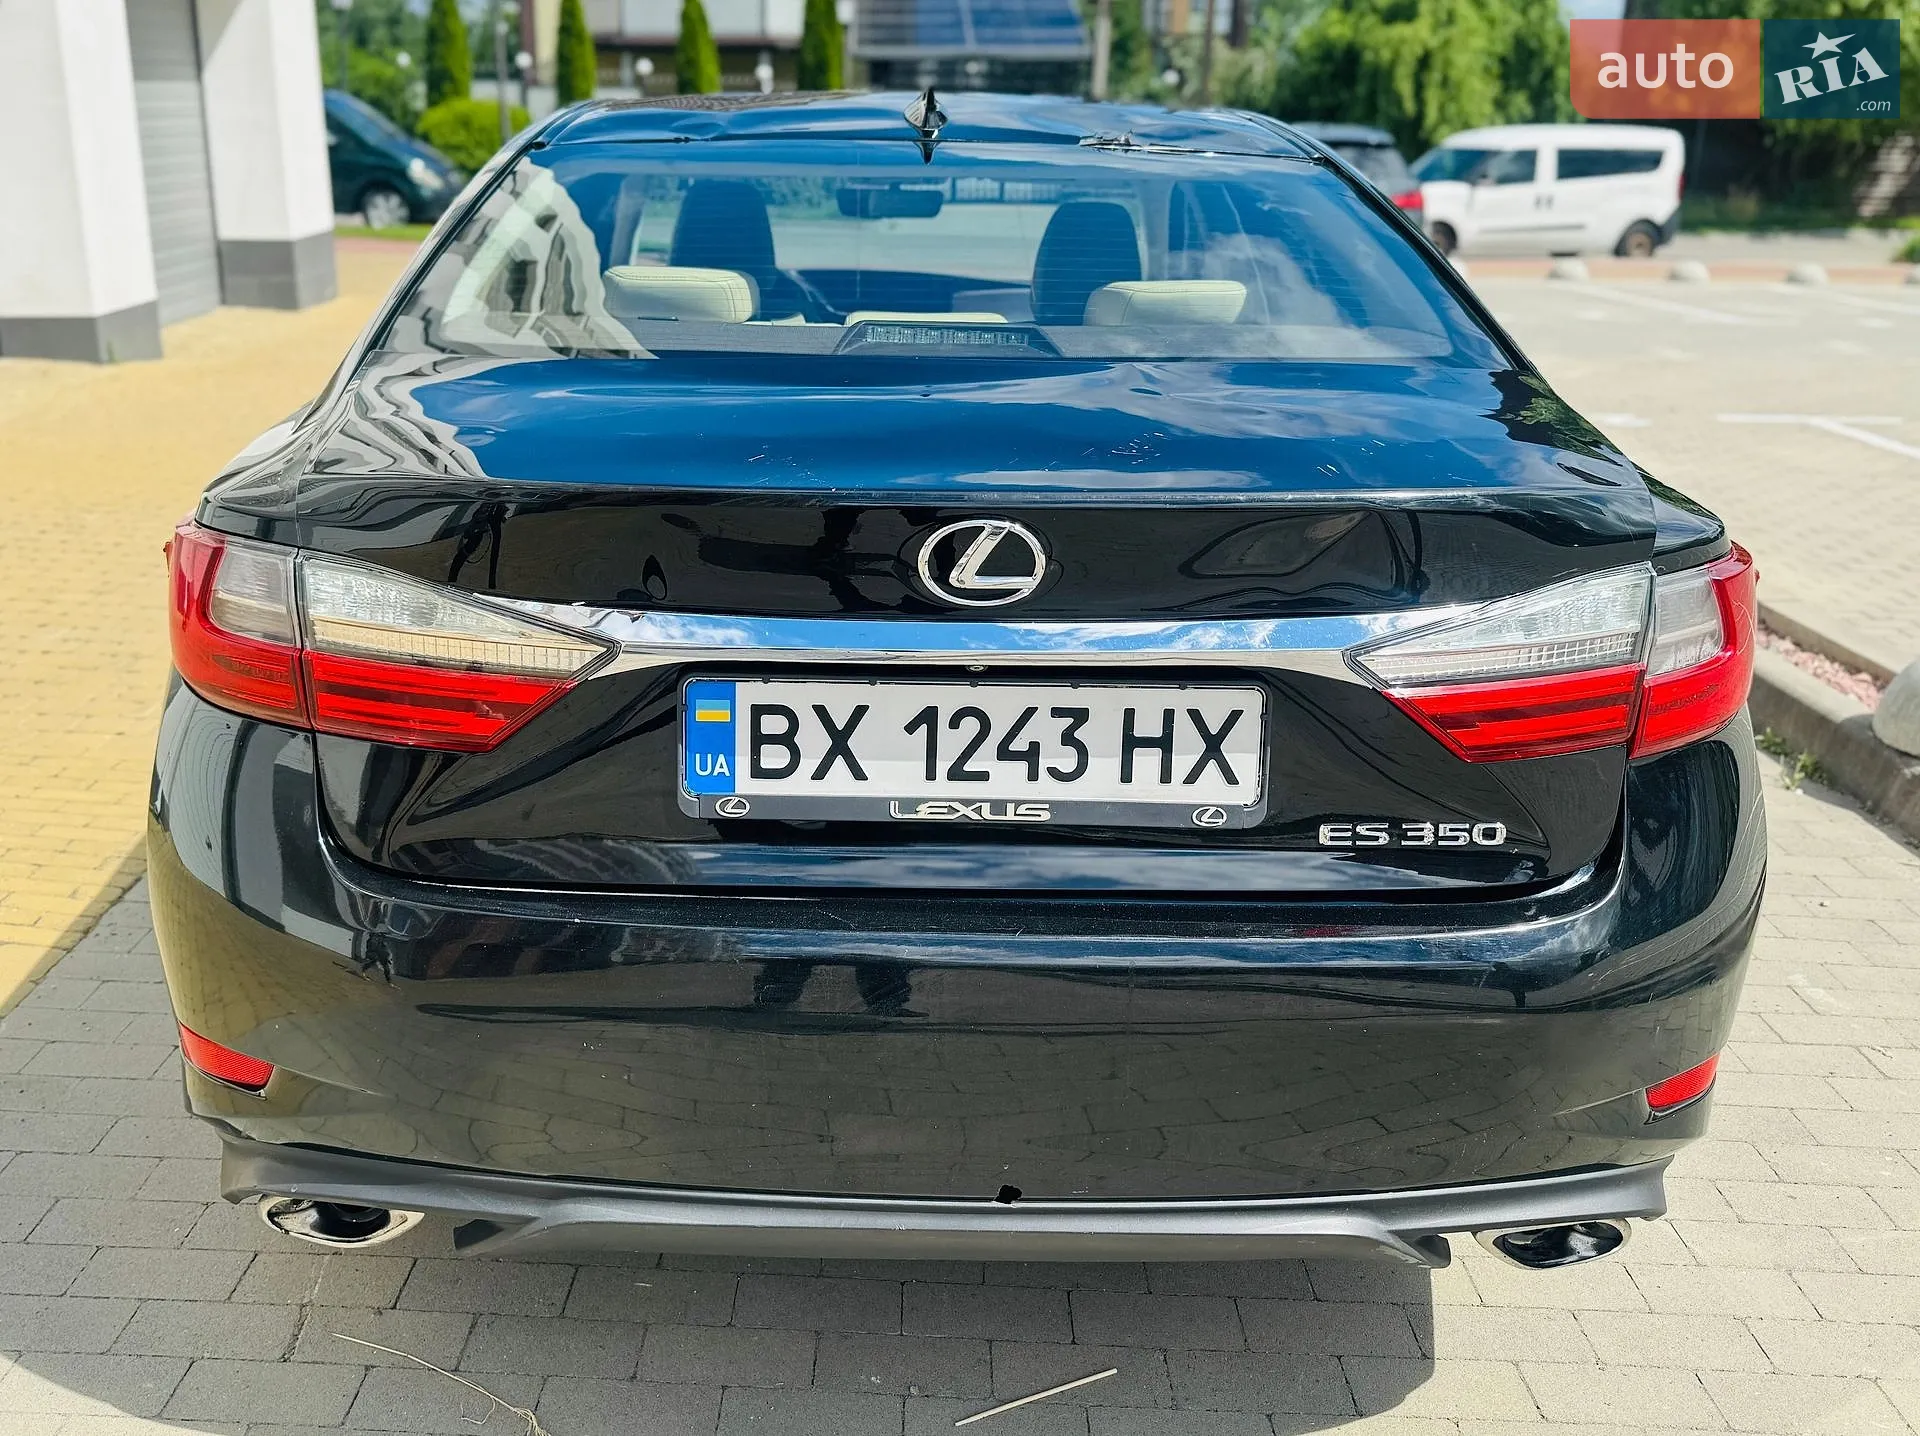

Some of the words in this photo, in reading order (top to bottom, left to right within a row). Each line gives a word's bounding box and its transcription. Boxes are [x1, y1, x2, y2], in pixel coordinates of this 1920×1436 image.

[749, 703, 870, 781] BX
[903, 705, 1089, 782] 1243
[1119, 707, 1243, 785] HX
[695, 753, 731, 777] UA
[889, 800, 1051, 822] LEXUS
[1318, 822, 1390, 847] ES
[1400, 822, 1507, 847] 350
